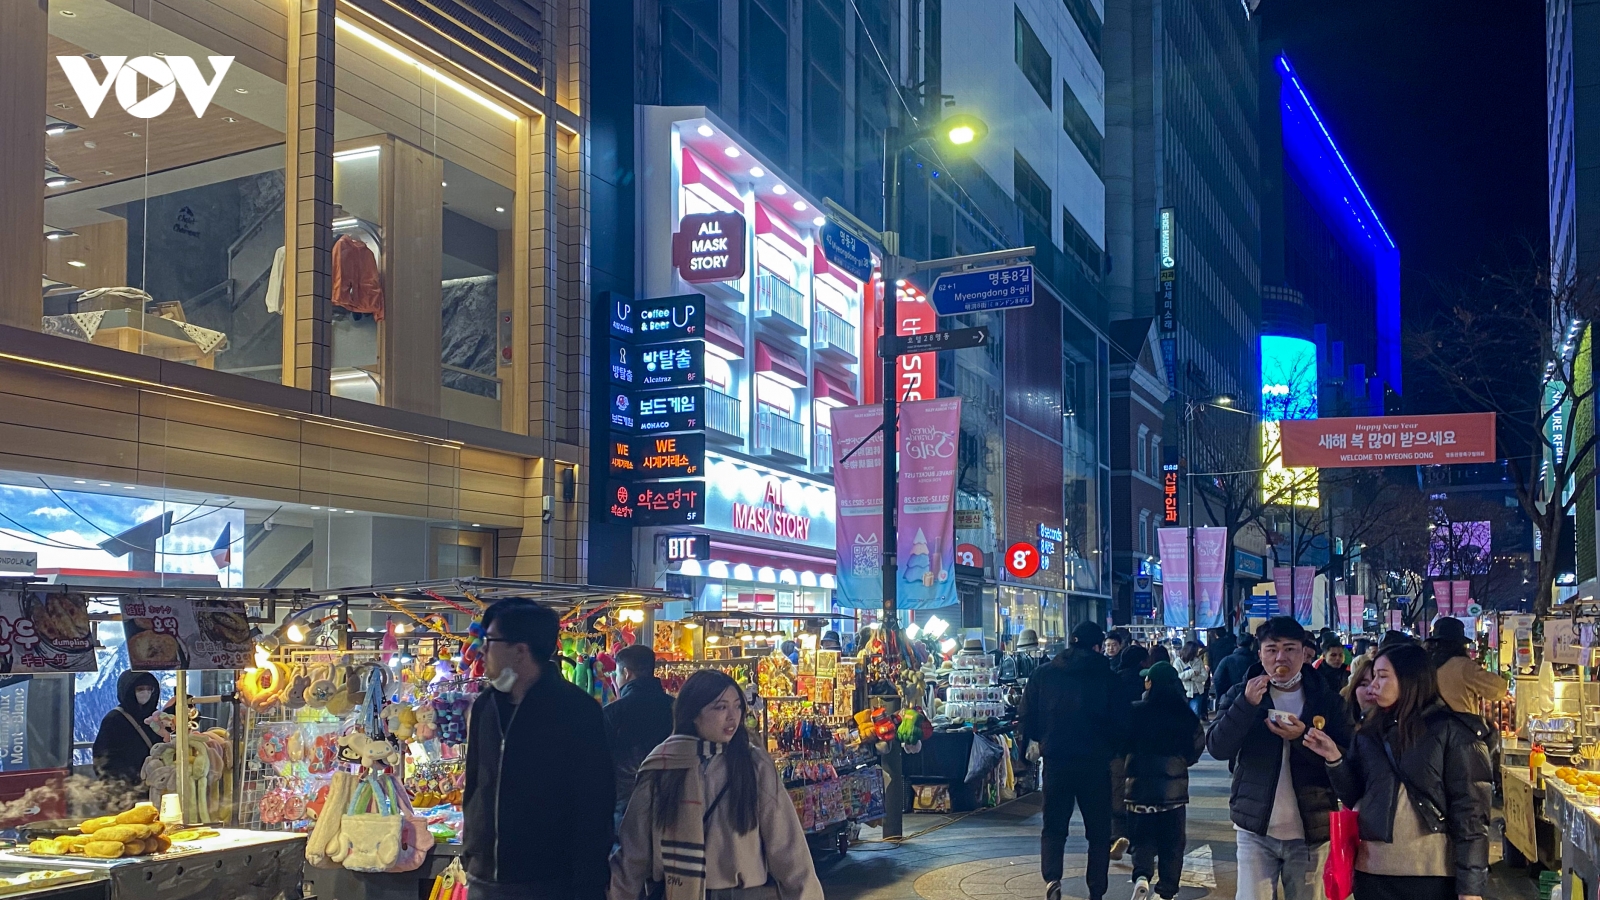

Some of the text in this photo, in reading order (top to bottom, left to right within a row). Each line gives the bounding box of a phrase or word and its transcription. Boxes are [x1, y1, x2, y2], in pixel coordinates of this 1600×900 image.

[698, 221, 722, 235] ALL
[691, 237, 728, 253] MASK
[840, 231, 856, 252] 명동길
[690, 255, 729, 270] STORY
[989, 268, 1029, 285] 명동8길
[955, 285, 1030, 301] Myeongdong 8-gil
[640, 309, 670, 319] Coffee
[641, 322, 648, 332] &
[650, 321, 670, 330] Beer
[643, 348, 692, 372] 방탈출
[612, 365, 633, 382] 방탈출
[643, 376, 672, 384] Alcatraz
[687, 373, 696, 381] 8F
[640, 396, 695, 415] 보드게임
[611, 414, 634, 428] 보드게임
[640, 422, 670, 430] MONACO
[687, 419, 696, 428] 7F
[1355, 424, 1381, 432] Happy
[655, 438, 676, 453] WE
[1318, 430, 1456, 449] 새해 복 많이 받으세요
[616, 443, 629, 456] WE
[1384, 452, 1413, 460] MYEONG
[611, 458, 634, 470] 시계거래소
[642, 454, 690, 469] 시계거래소
[686, 466, 697, 474] 6F
[637, 488, 698, 510] 약손명가
[764, 481, 785, 509] ALL
[1165, 472, 1177, 522] 산부인과
[610, 504, 633, 518] 약손명가
[686, 512, 697, 520] 5F
[733, 502, 810, 540] MASK STORY
[958, 515, 980, 524] 부동산
[668, 538, 696, 558] BTC
[152, 616, 179, 638] 호떡
[53, 638, 90, 648] dumpling
[21, 653, 67, 667] ギョーザ
